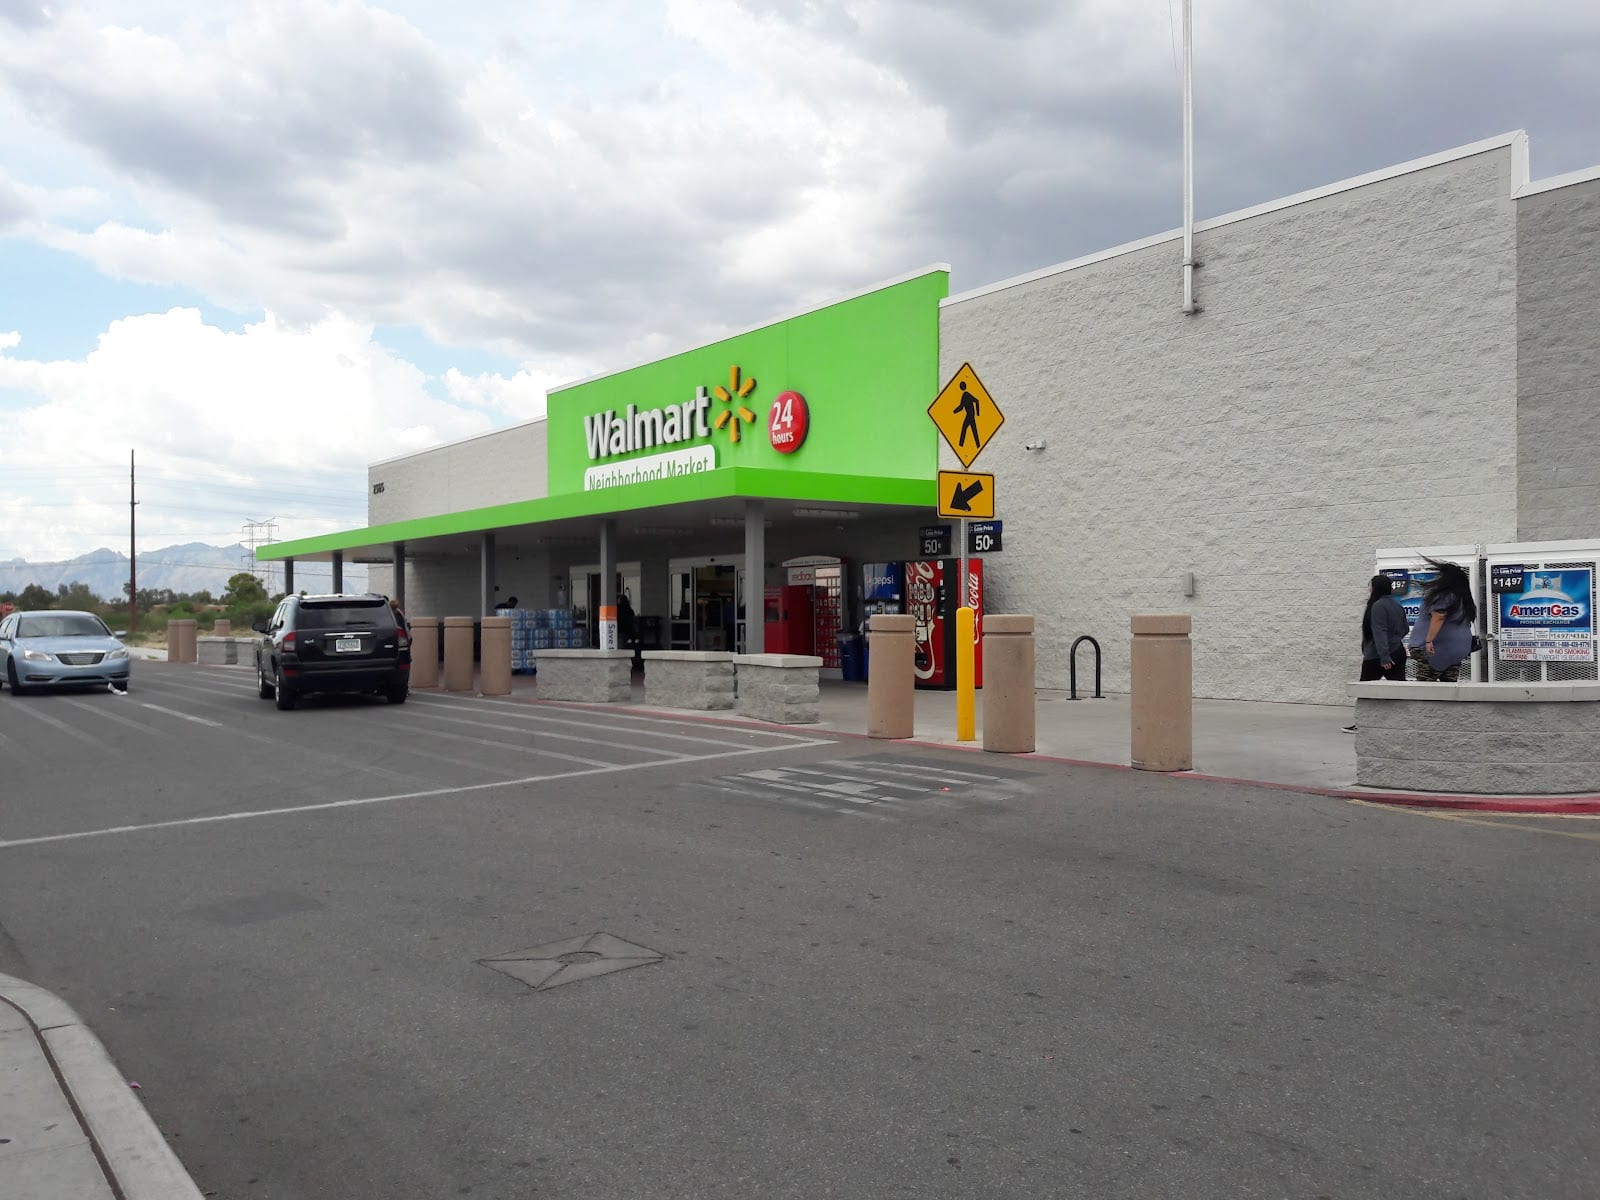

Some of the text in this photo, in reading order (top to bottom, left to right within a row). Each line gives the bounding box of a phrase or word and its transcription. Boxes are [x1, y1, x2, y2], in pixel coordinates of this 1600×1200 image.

[584, 386, 711, 459] Walmart
[772, 399, 793, 431] 24
[772, 432, 794, 445] hours
[667, 456, 708, 478] Market
[1391, 580, 1406, 590] 497
[1509, 604, 1580, 618] AmeriGas
